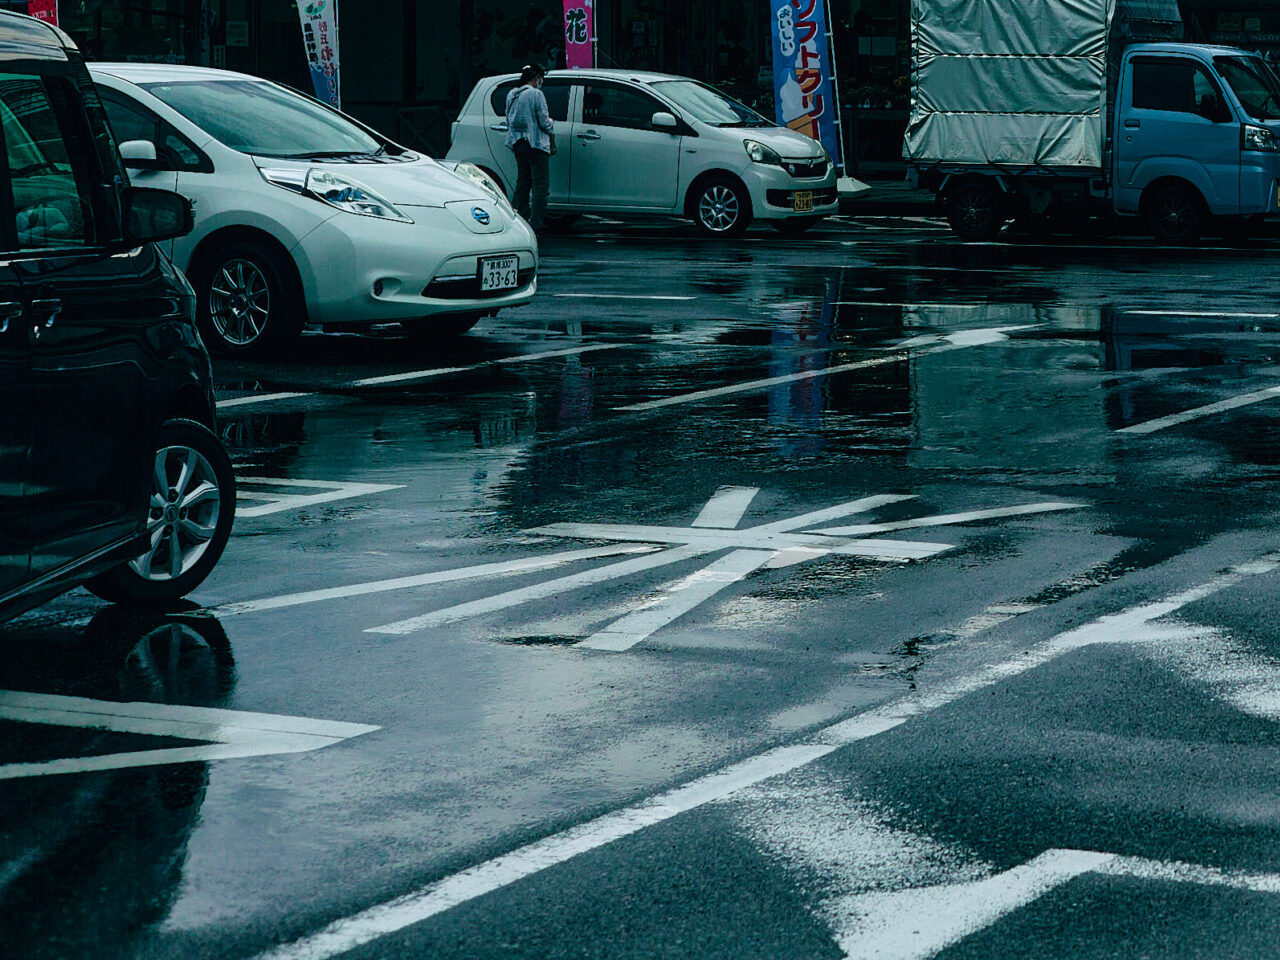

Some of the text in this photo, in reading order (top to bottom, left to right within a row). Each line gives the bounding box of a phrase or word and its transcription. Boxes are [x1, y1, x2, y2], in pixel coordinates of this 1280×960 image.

[566, 8, 587, 43] 花
[778, 8, 794, 52] おいしい
